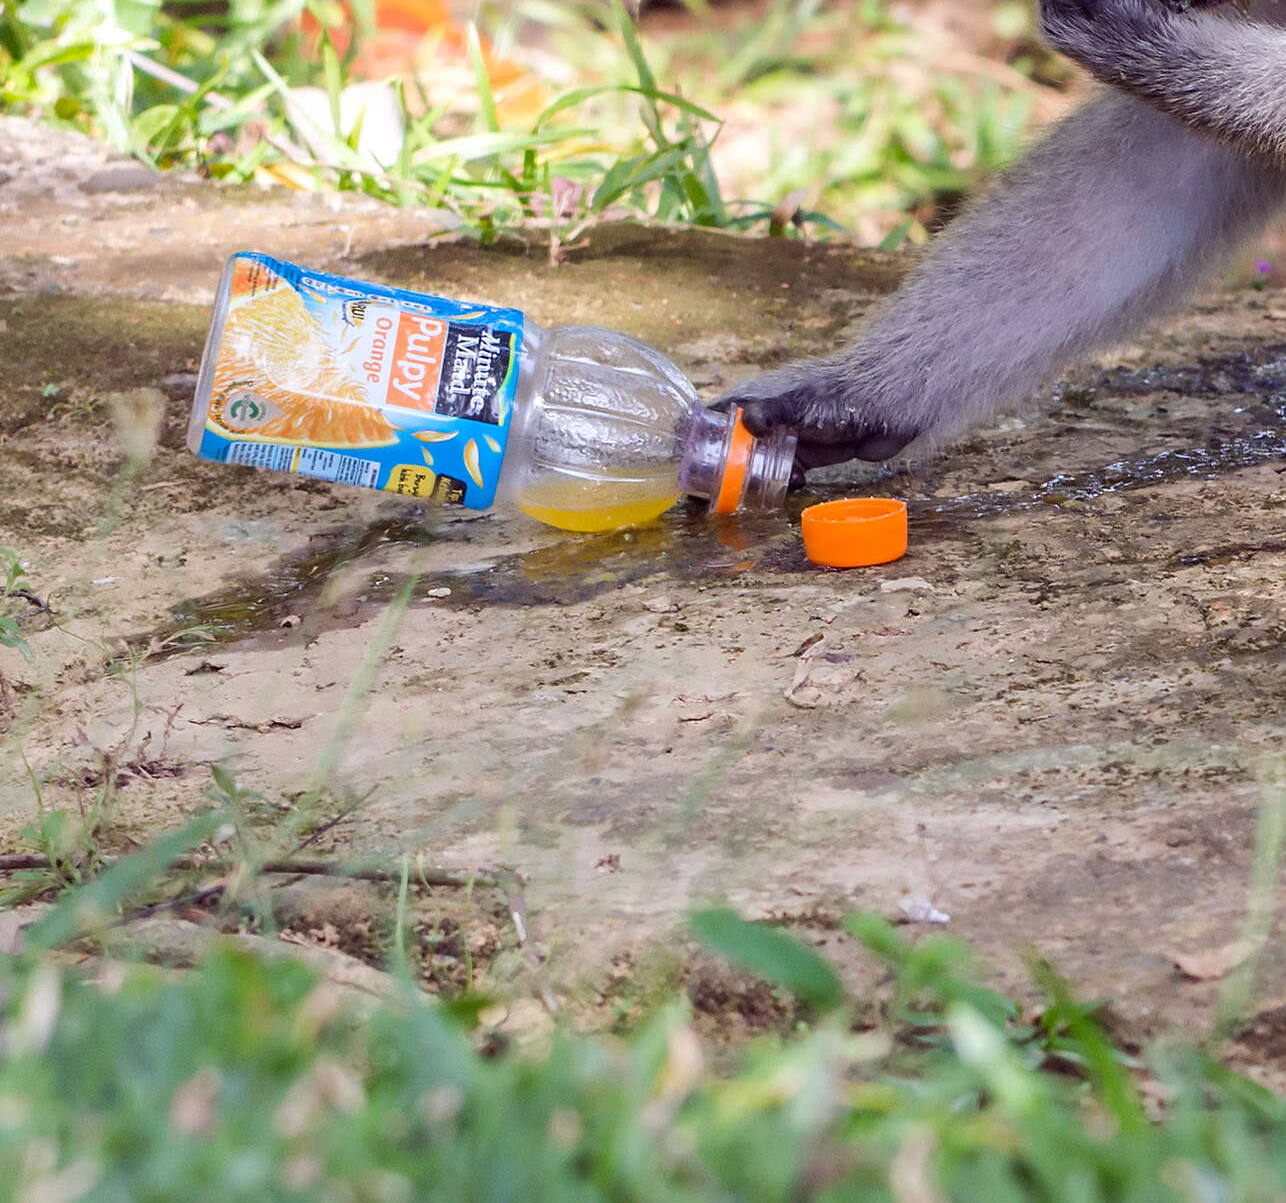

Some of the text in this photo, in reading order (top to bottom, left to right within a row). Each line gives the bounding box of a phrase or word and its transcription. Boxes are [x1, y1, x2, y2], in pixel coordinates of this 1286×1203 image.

[362, 317, 393, 384] Orange
[392, 316, 443, 401] Pulpy
[450, 334, 480, 396] Maid
[470, 329, 501, 413] Minute
